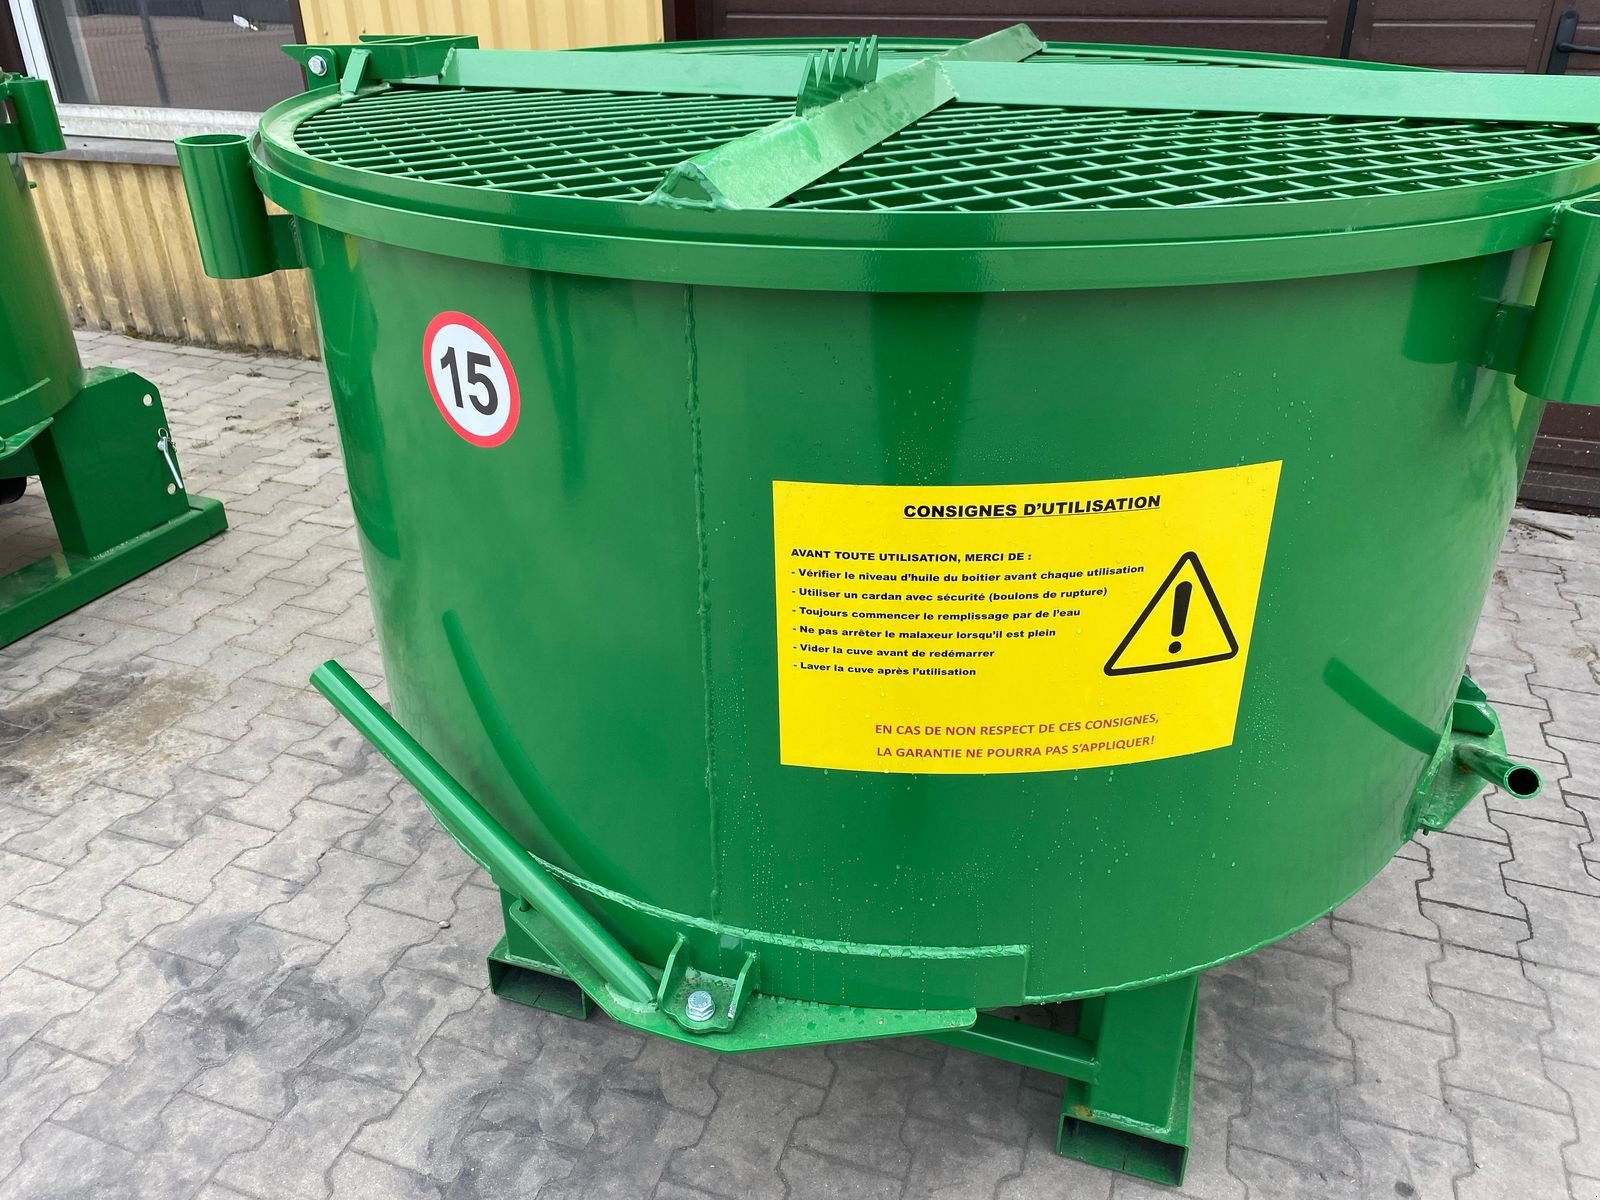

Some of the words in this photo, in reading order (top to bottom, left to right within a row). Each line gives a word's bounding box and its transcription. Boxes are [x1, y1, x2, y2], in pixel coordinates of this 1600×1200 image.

[440, 346, 498, 415] 15
[903, 504, 1017, 518] CONSIGNES
[791, 548, 831, 559] AVANT
[834, 551, 875, 561] TOUTE
[879, 553, 961, 564] UTILISATION,
[964, 553, 1004, 562] MERCI
[1007, 552, 1025, 561] DE
[798, 568, 842, 579] Vérifier
[844, 571, 856, 580] le
[858, 572, 897, 581] niveau
[943, 573, 958, 582] du
[961, 573, 1001, 582] boitier
[1003, 572, 1037, 581] avant
[1040, 571, 1084, 580] chaque
[1086, 565, 1145, 577] utilisation
[799, 587, 841, 598] Utiliser
[861, 592, 902, 601] cardan
[936, 592, 986, 602] sécurité
[988, 592, 1039, 603] (boulons
[1042, 590, 1057, 599] de
[1060, 587, 1108, 599] rupture)
[799, 606, 848, 618] Toujours
[851, 611, 921, 620] commencer
[923, 612, 934, 621] le
[937, 612, 1010, 622] remplissage
[1012, 612, 1033, 621] par
[1035, 610, 1050, 619] de
[799, 625, 815, 634] Ne
[818, 628, 839, 636] pas
[841, 629, 882, 638] arrêter
[884, 630, 896, 639] le
[898, 631, 954, 639] malaxeur
[1005, 630, 1025, 639] est
[1027, 628, 1056, 639] plein
[799, 643, 830, 653] Vider
[832, 646, 843, 654] la
[846, 648, 873, 656] cuve
[876, 649, 909, 657] avant
[911, 649, 926, 658] de
[929, 649, 995, 658] redémarrer
[800, 661, 831, 671] Laver
[834, 664, 844, 672] la
[847, 666, 874, 674] cuve
[877, 667, 910, 676] après
[875, 724, 892, 735] EN
[896, 725, 921, 736] CAS
[925, 726, 942, 736] DE
[945, 726, 976, 736] NON
[980, 724, 1035, 736] RESPECT
[1038, 723, 1055, 734] DE
[1059, 721, 1081, 732] CES
[1085, 713, 1159, 730] CONSIGNES,
[877, 747, 892, 757] LA
[895, 748, 962, 758] GARANTIE
[966, 748, 983, 758] NE
[987, 747, 1042, 758] POURRA
[1045, 745, 1069, 755] PAS
